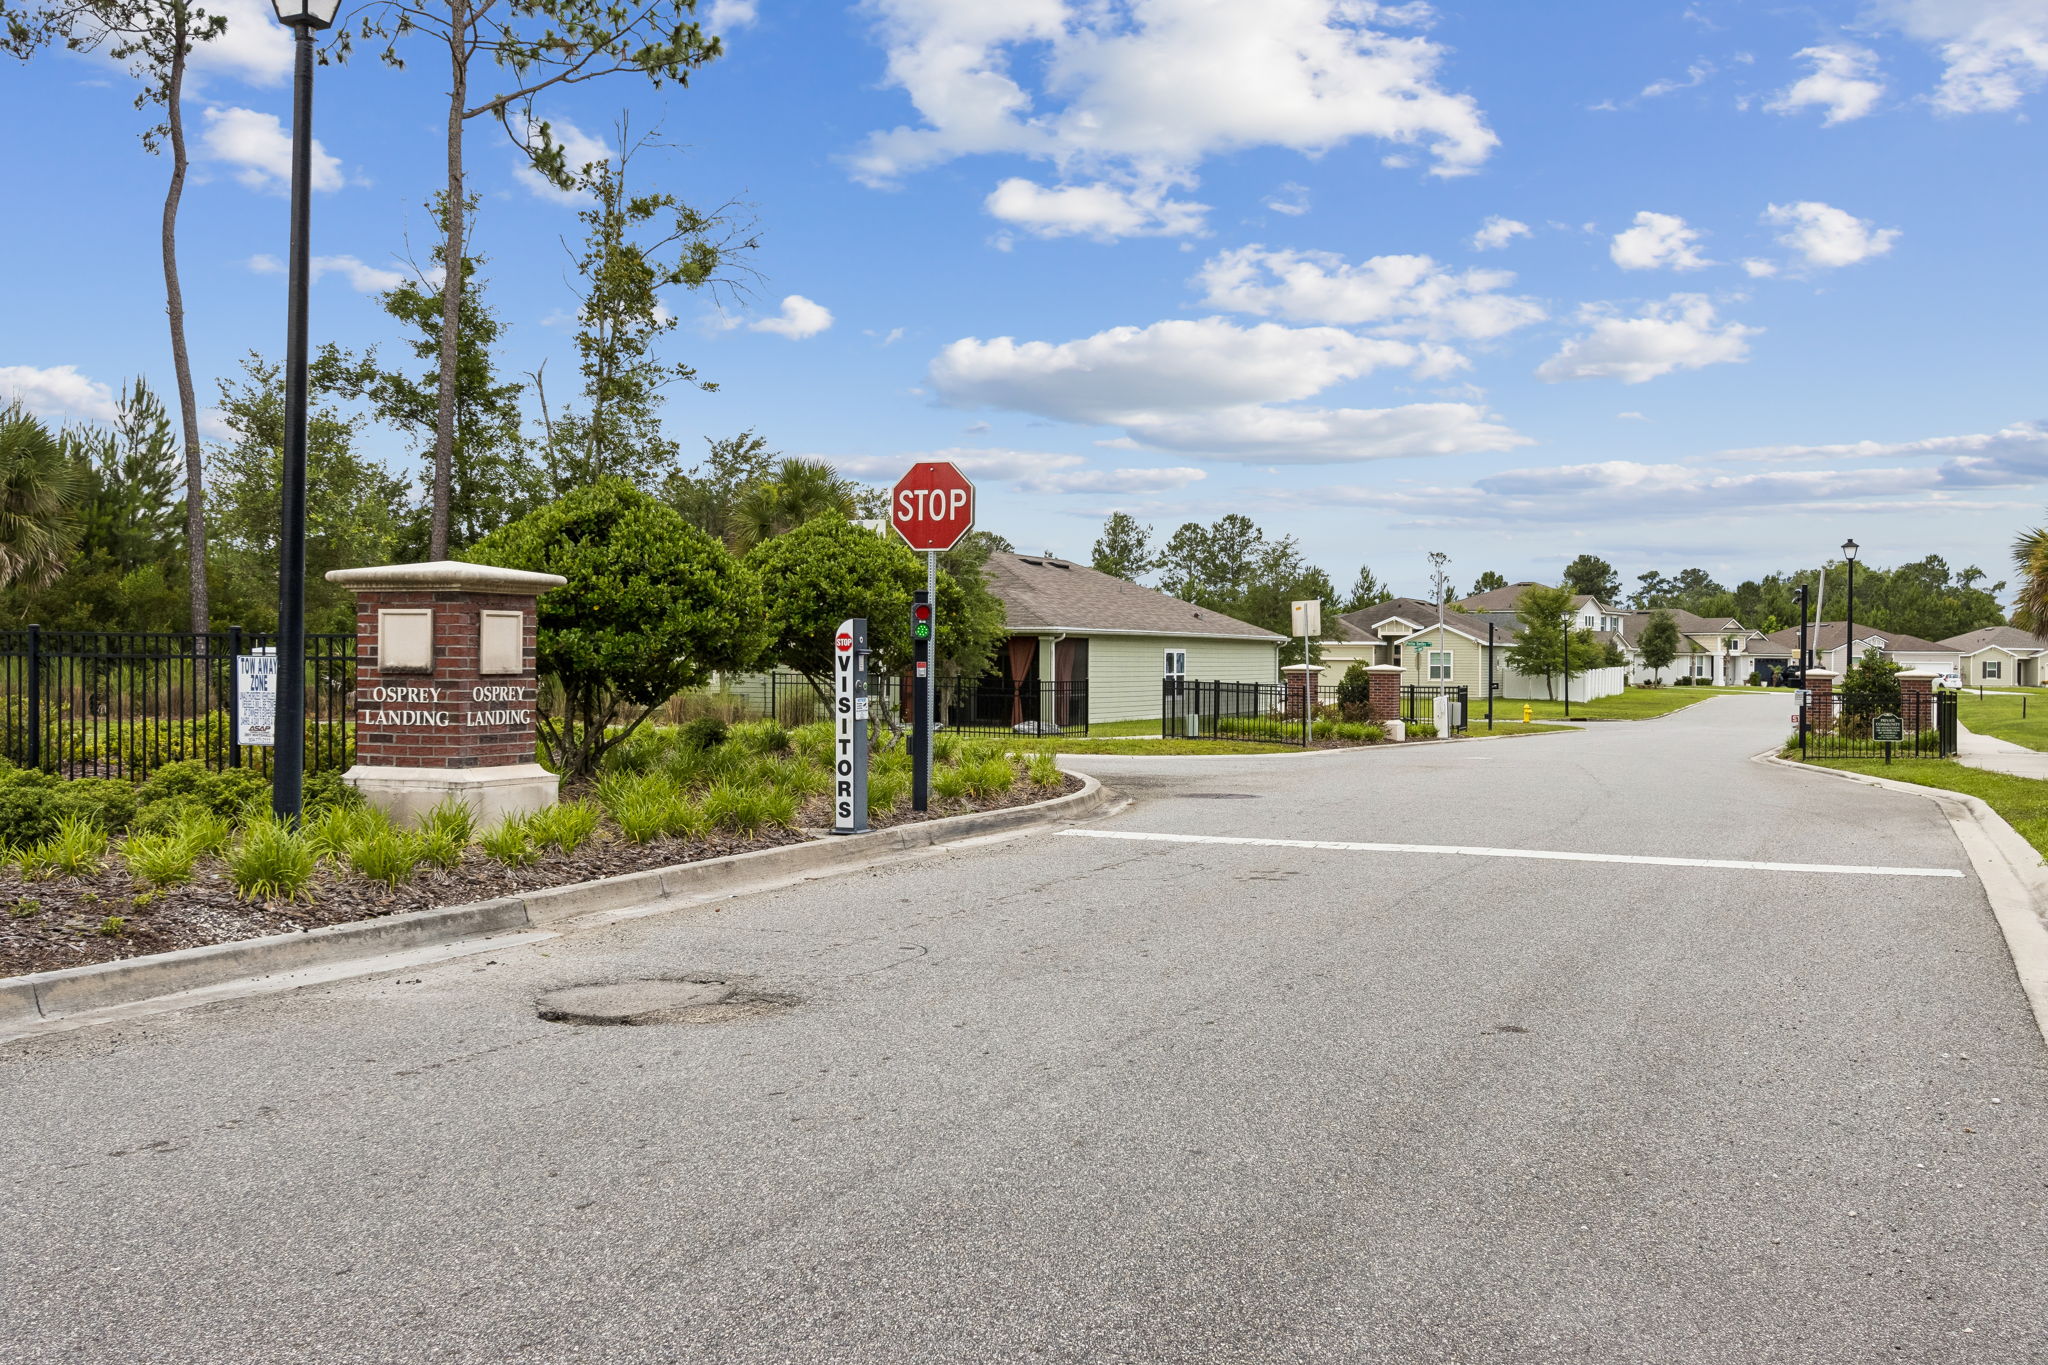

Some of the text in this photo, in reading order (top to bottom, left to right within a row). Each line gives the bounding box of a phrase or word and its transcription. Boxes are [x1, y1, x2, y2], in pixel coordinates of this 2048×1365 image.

[897, 488, 967, 522] STOP
[836, 638, 852, 647] STOP
[241, 657, 278, 675] TOW AWAY
[250, 674, 268, 692] ZONE
[373, 686, 442, 703] OSPREY
[472, 686, 526, 702] OSPREY
[365, 709, 449, 727] LANDING
[466, 709, 531, 727] LANDING
[837, 655, 851, 819] VISITORS
